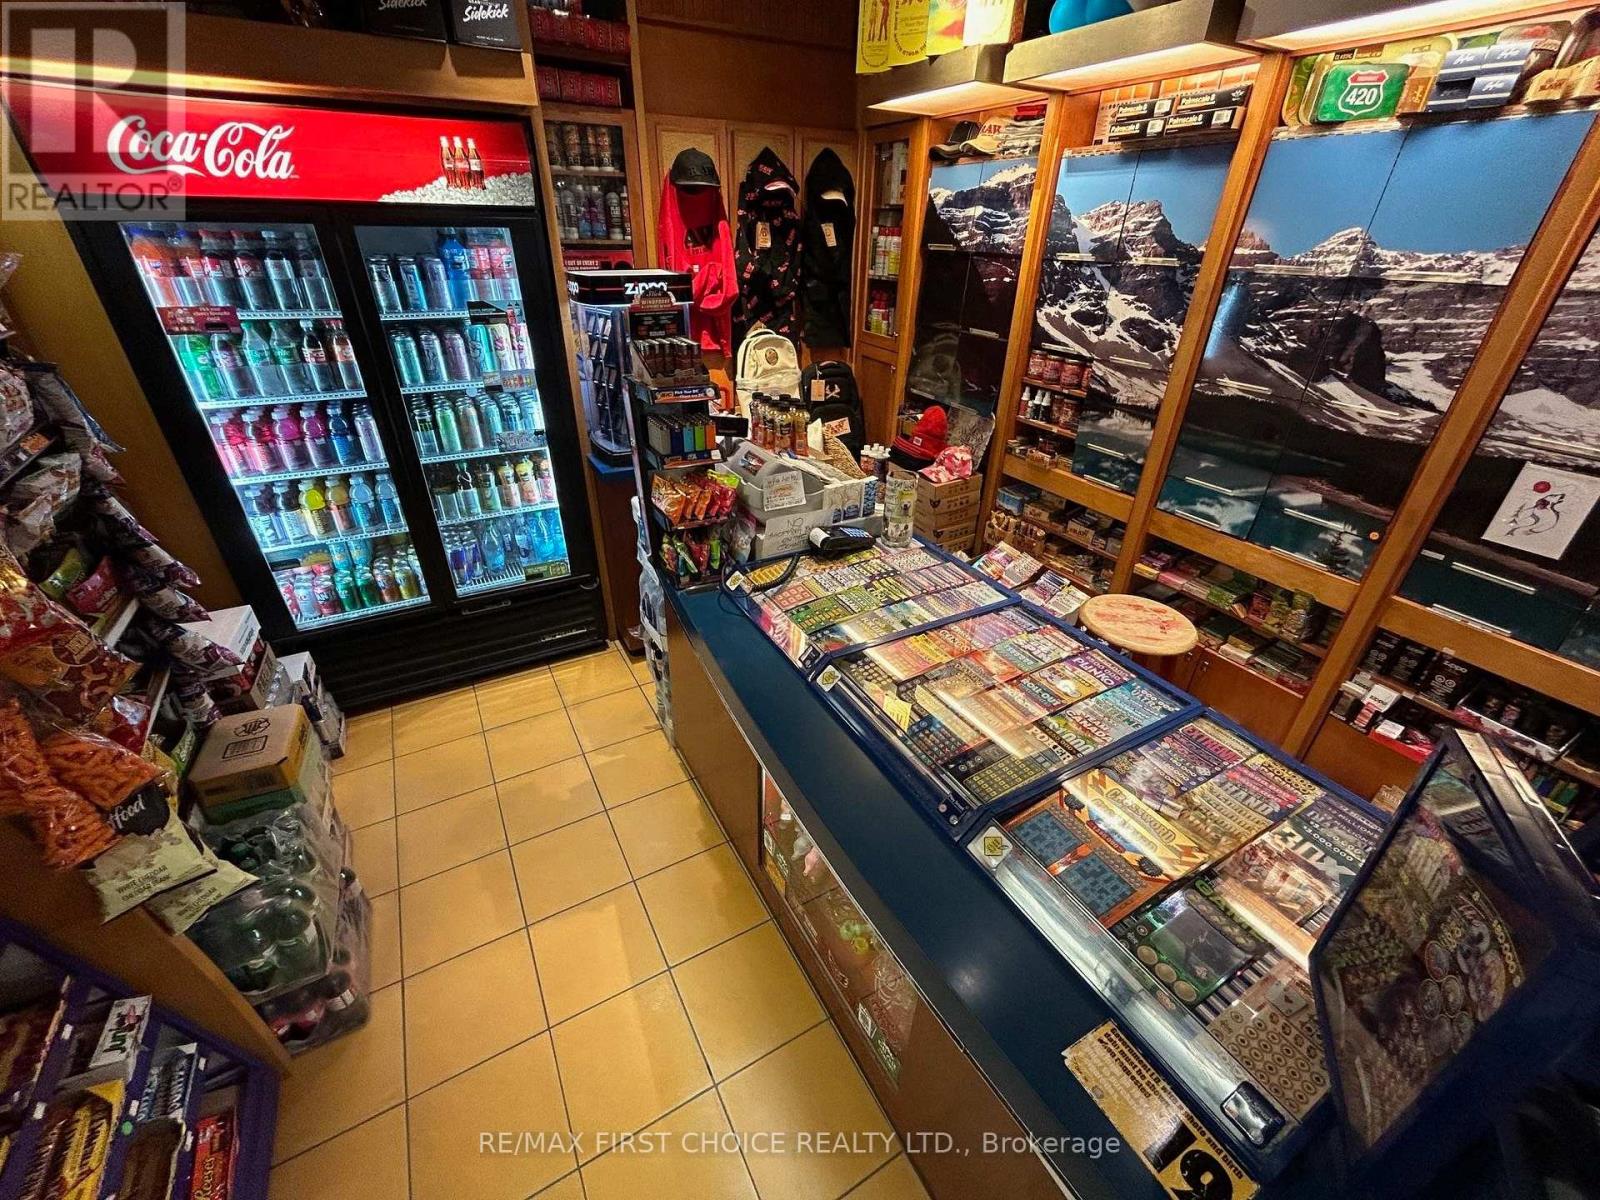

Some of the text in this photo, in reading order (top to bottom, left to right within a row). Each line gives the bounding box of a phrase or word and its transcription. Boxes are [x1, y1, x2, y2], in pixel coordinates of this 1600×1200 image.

[462, 3, 509, 22] Sidekick
[1345, 88, 1378, 106] 420
[107, 115, 295, 179] Coca-Cola
[1071, 656, 1115, 687] PLINKO
[1027, 725, 1074, 764] POKER
[1064, 708, 1113, 743] CANADA
[1181, 723, 1241, 763] EXTREME
[1105, 786, 1177, 845] CROSSWORD
[1219, 781, 1274, 816] HAND
[1271, 824, 1357, 883] 30X
[1112, 1055, 1152, 1100] requested
[1117, 1047, 1138, 1071] must
[1135, 1067, 1147, 1081] be
[1144, 1078, 1171, 1109] shown
[1109, 1026, 1152, 1074] Government
[1181, 1109, 1208, 1138] photo
[1202, 1133, 1224, 1156] and
[1219, 1153, 1245, 1181] birth
[1143, 1112, 1234, 1200] 19
